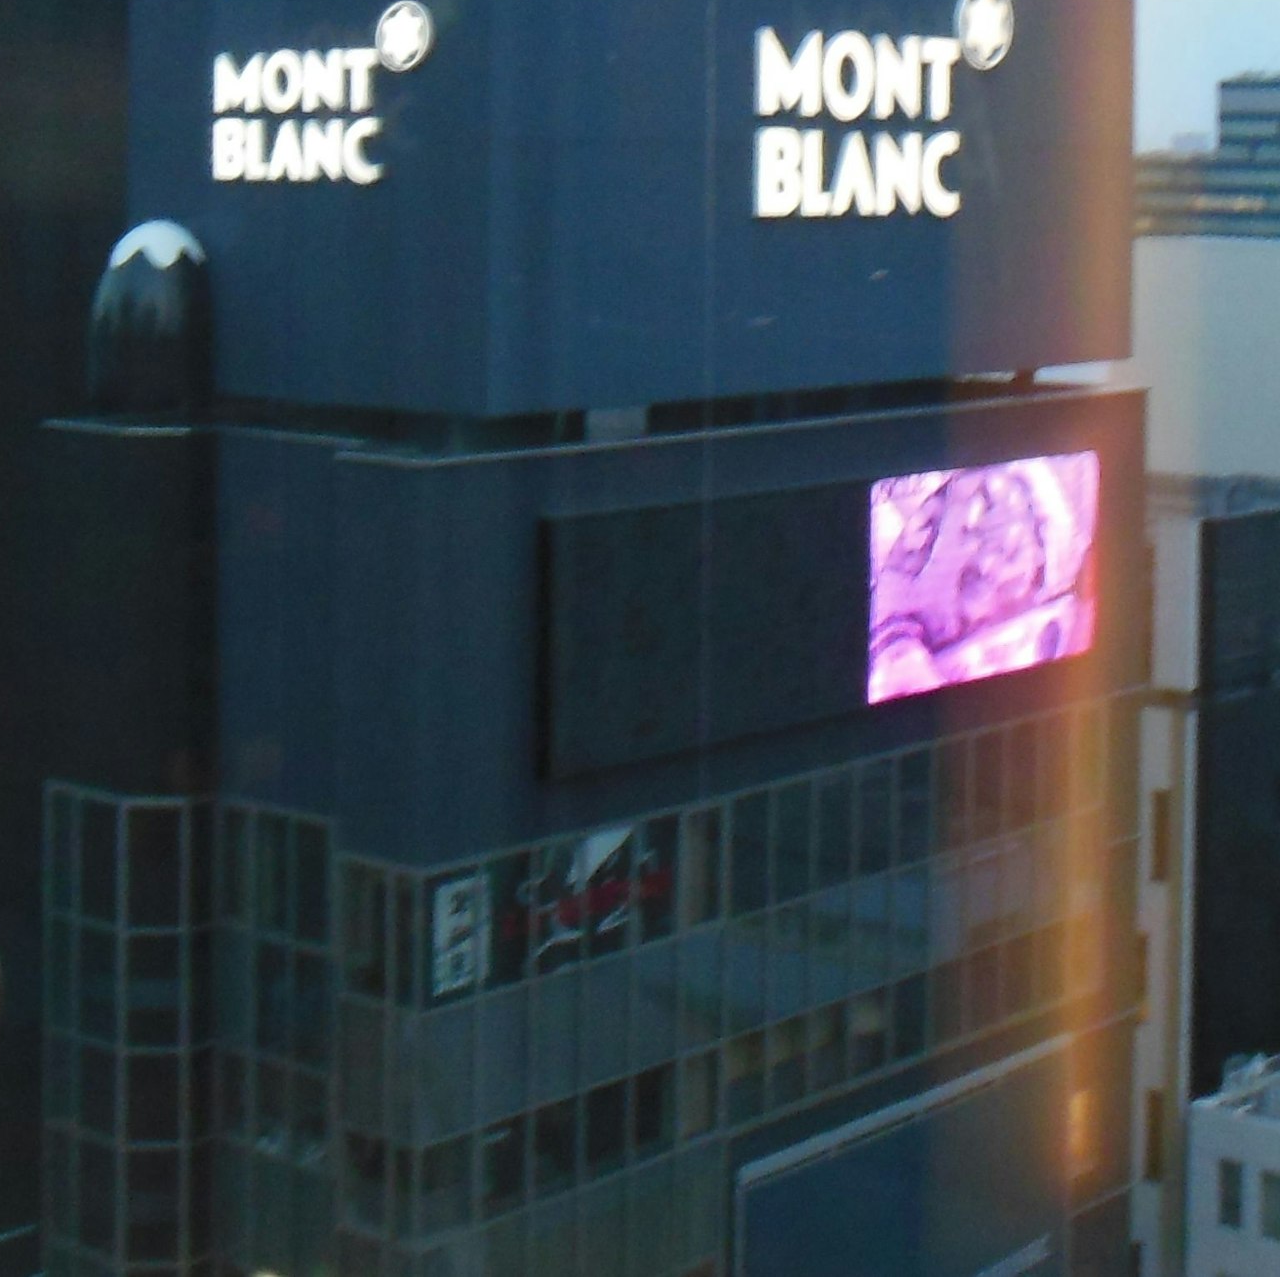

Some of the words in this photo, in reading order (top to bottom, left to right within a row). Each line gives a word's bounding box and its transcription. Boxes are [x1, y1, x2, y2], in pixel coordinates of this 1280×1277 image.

[213, 48, 380, 113] MONT
[755, 25, 961, 122] MONT
[212, 117, 383, 184] BLANC
[754, 126, 961, 218] BLANC
